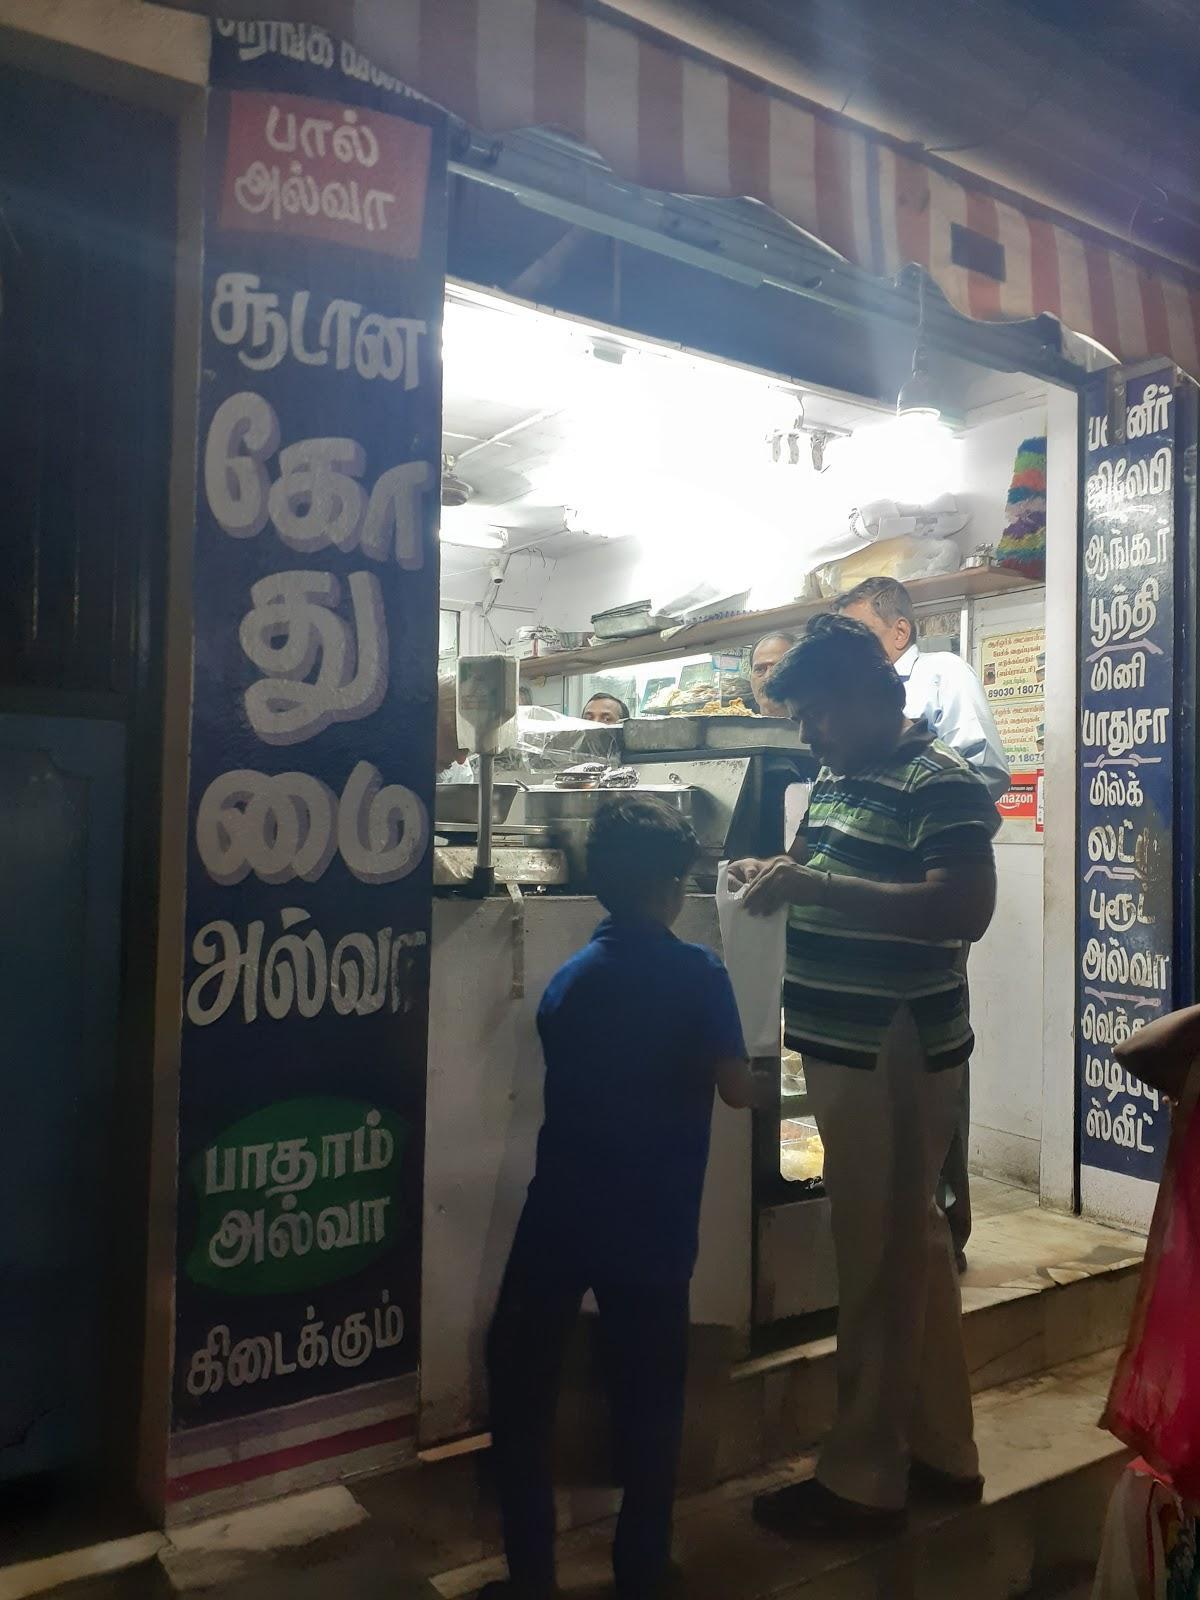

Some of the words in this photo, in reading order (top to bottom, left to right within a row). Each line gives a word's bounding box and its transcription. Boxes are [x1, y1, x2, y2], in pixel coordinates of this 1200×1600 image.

[265, 105, 379, 168] பால்
[234, 160, 395, 231] அல்வா
[210, 272, 427, 390] சூடான
[1086, 447, 1173, 512] ஜிலேபி
[1085, 521, 1171, 581] ஆங்கூர்
[1090, 577, 1159, 648] பூந்தி
[988, 687, 1014, 698] 89030
[1017, 684, 1044, 695] 18071
[1090, 652, 1146, 691] மினி
[1082, 707, 1170, 757] பாதுசா
[997, 793, 1033, 804] mazon
[1089, 770, 1143, 807] மில்க்
[186, 907, 427, 1026] அல்வா
[1082, 937, 1170, 990] அல்வா
[205, 1109, 394, 1198] பாதாம்
[1086, 1098, 1155, 1154] ஸ்வீட்
[209, 1194, 391, 1268] அல்வா
[186, 1289, 404, 1396] கிடைக்கும்
